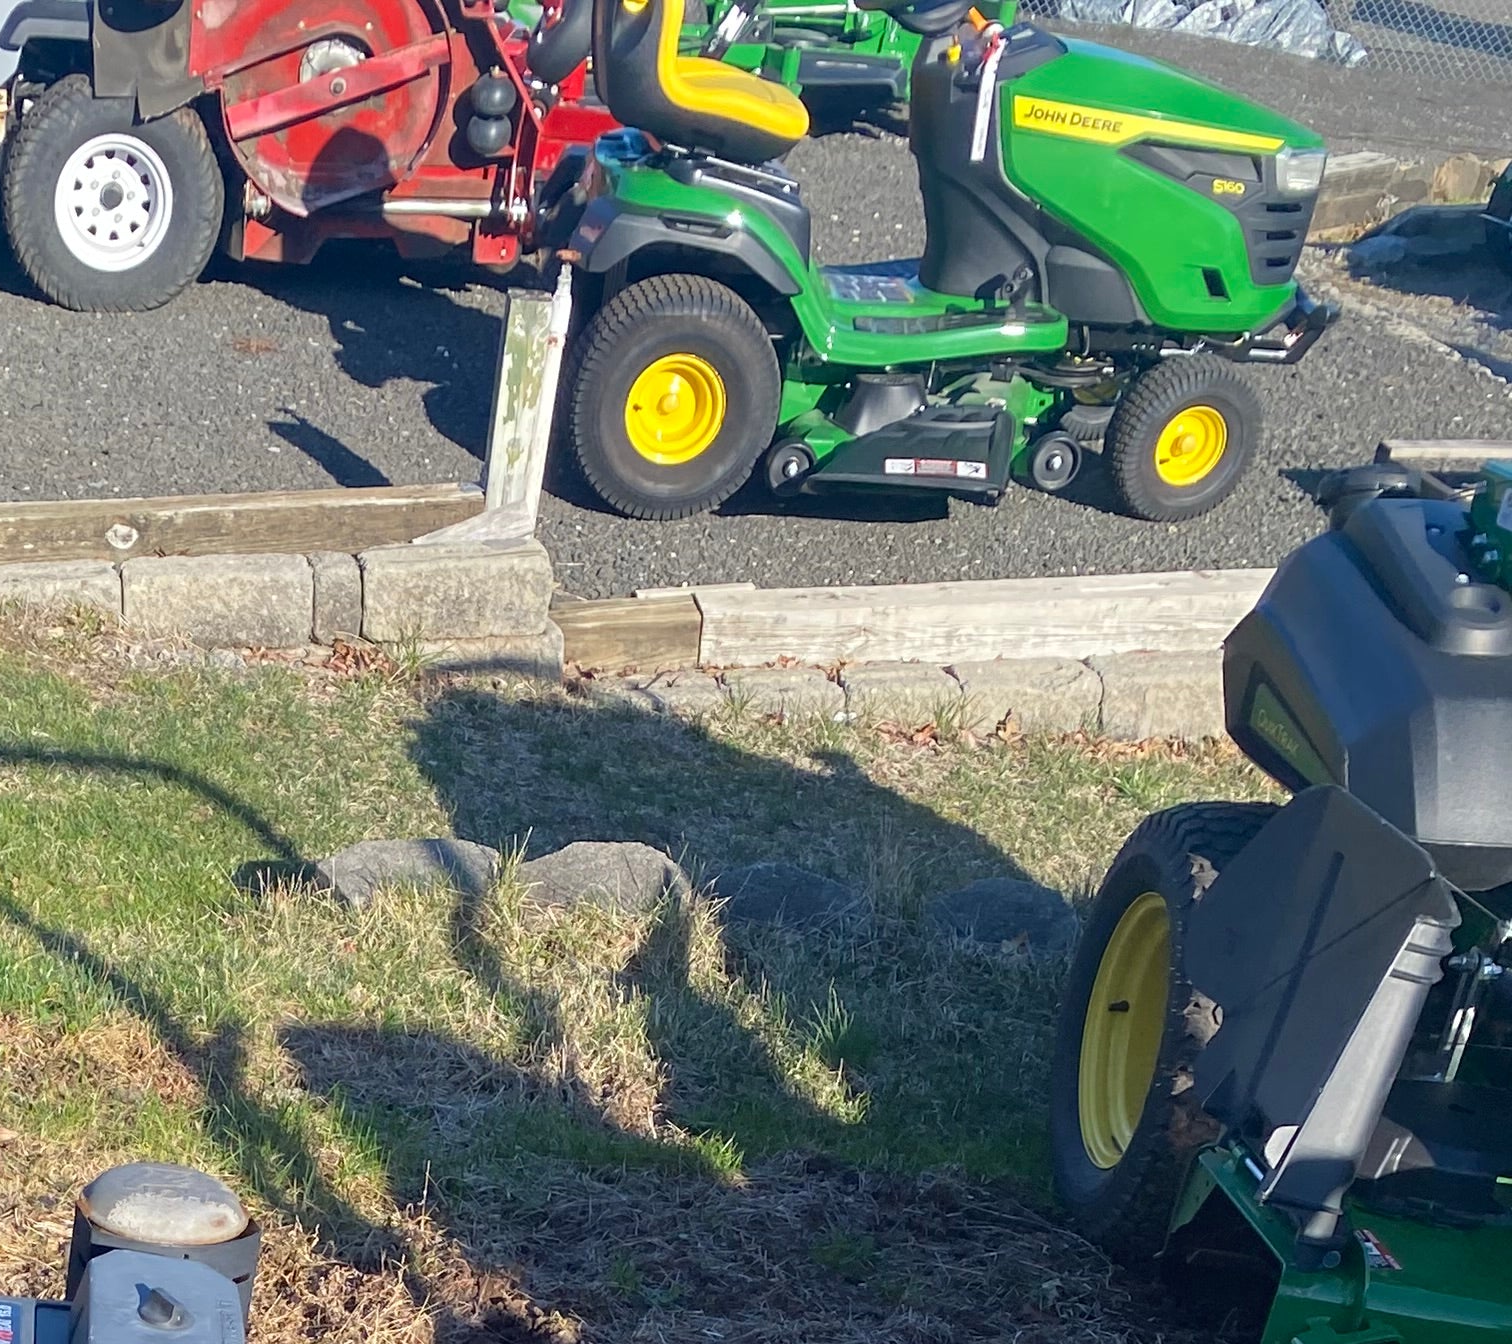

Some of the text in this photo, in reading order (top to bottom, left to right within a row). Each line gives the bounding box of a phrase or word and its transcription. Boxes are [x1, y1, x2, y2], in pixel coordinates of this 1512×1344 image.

[1024, 104, 1123, 133] JOHN DEERE
[1212, 178, 1246, 195] S160
